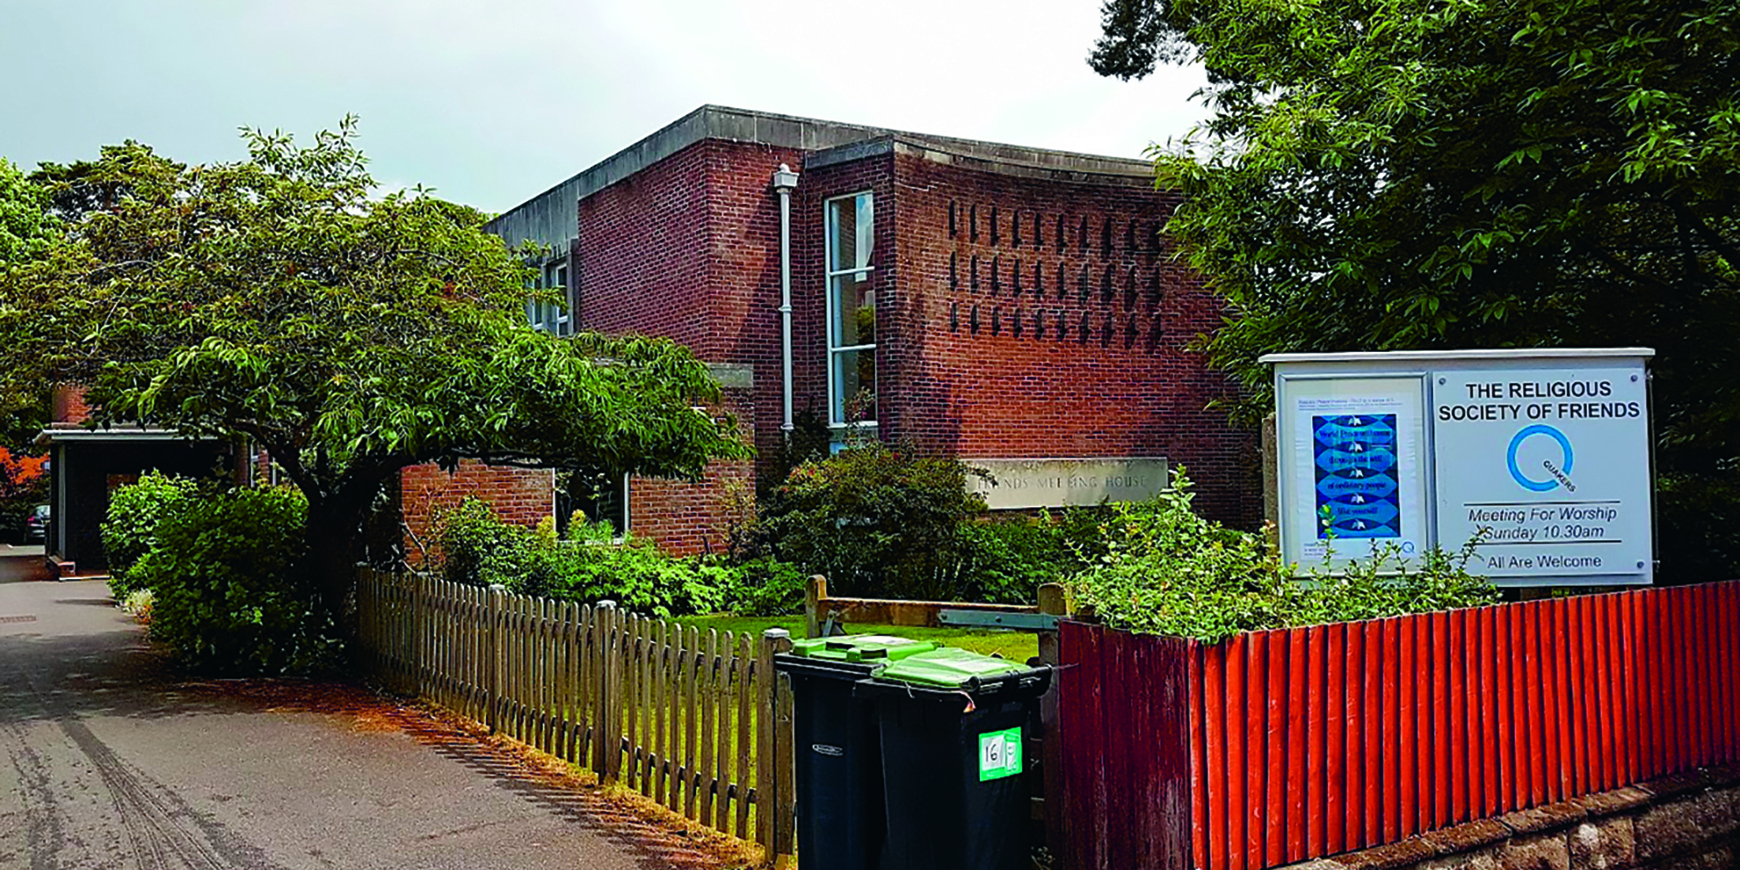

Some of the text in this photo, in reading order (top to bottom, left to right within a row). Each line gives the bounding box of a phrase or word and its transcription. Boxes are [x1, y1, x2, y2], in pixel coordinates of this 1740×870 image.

[1466, 381, 1612, 399] THE RELIGIOUS
[1439, 402, 1640, 421] SOCIETY OF FRIENDS
[977, 477, 1029, 489] FRNDS
[1106, 476, 1147, 488] HOUSE
[1543, 460, 1577, 492] QUAKERS
[1468, 507, 1617, 524] Meeting For Worship
[1483, 525, 1604, 541] Sunday 10.30am
[1487, 555, 1602, 569] All Are Welcome
[985, 744, 998, 763] 16
